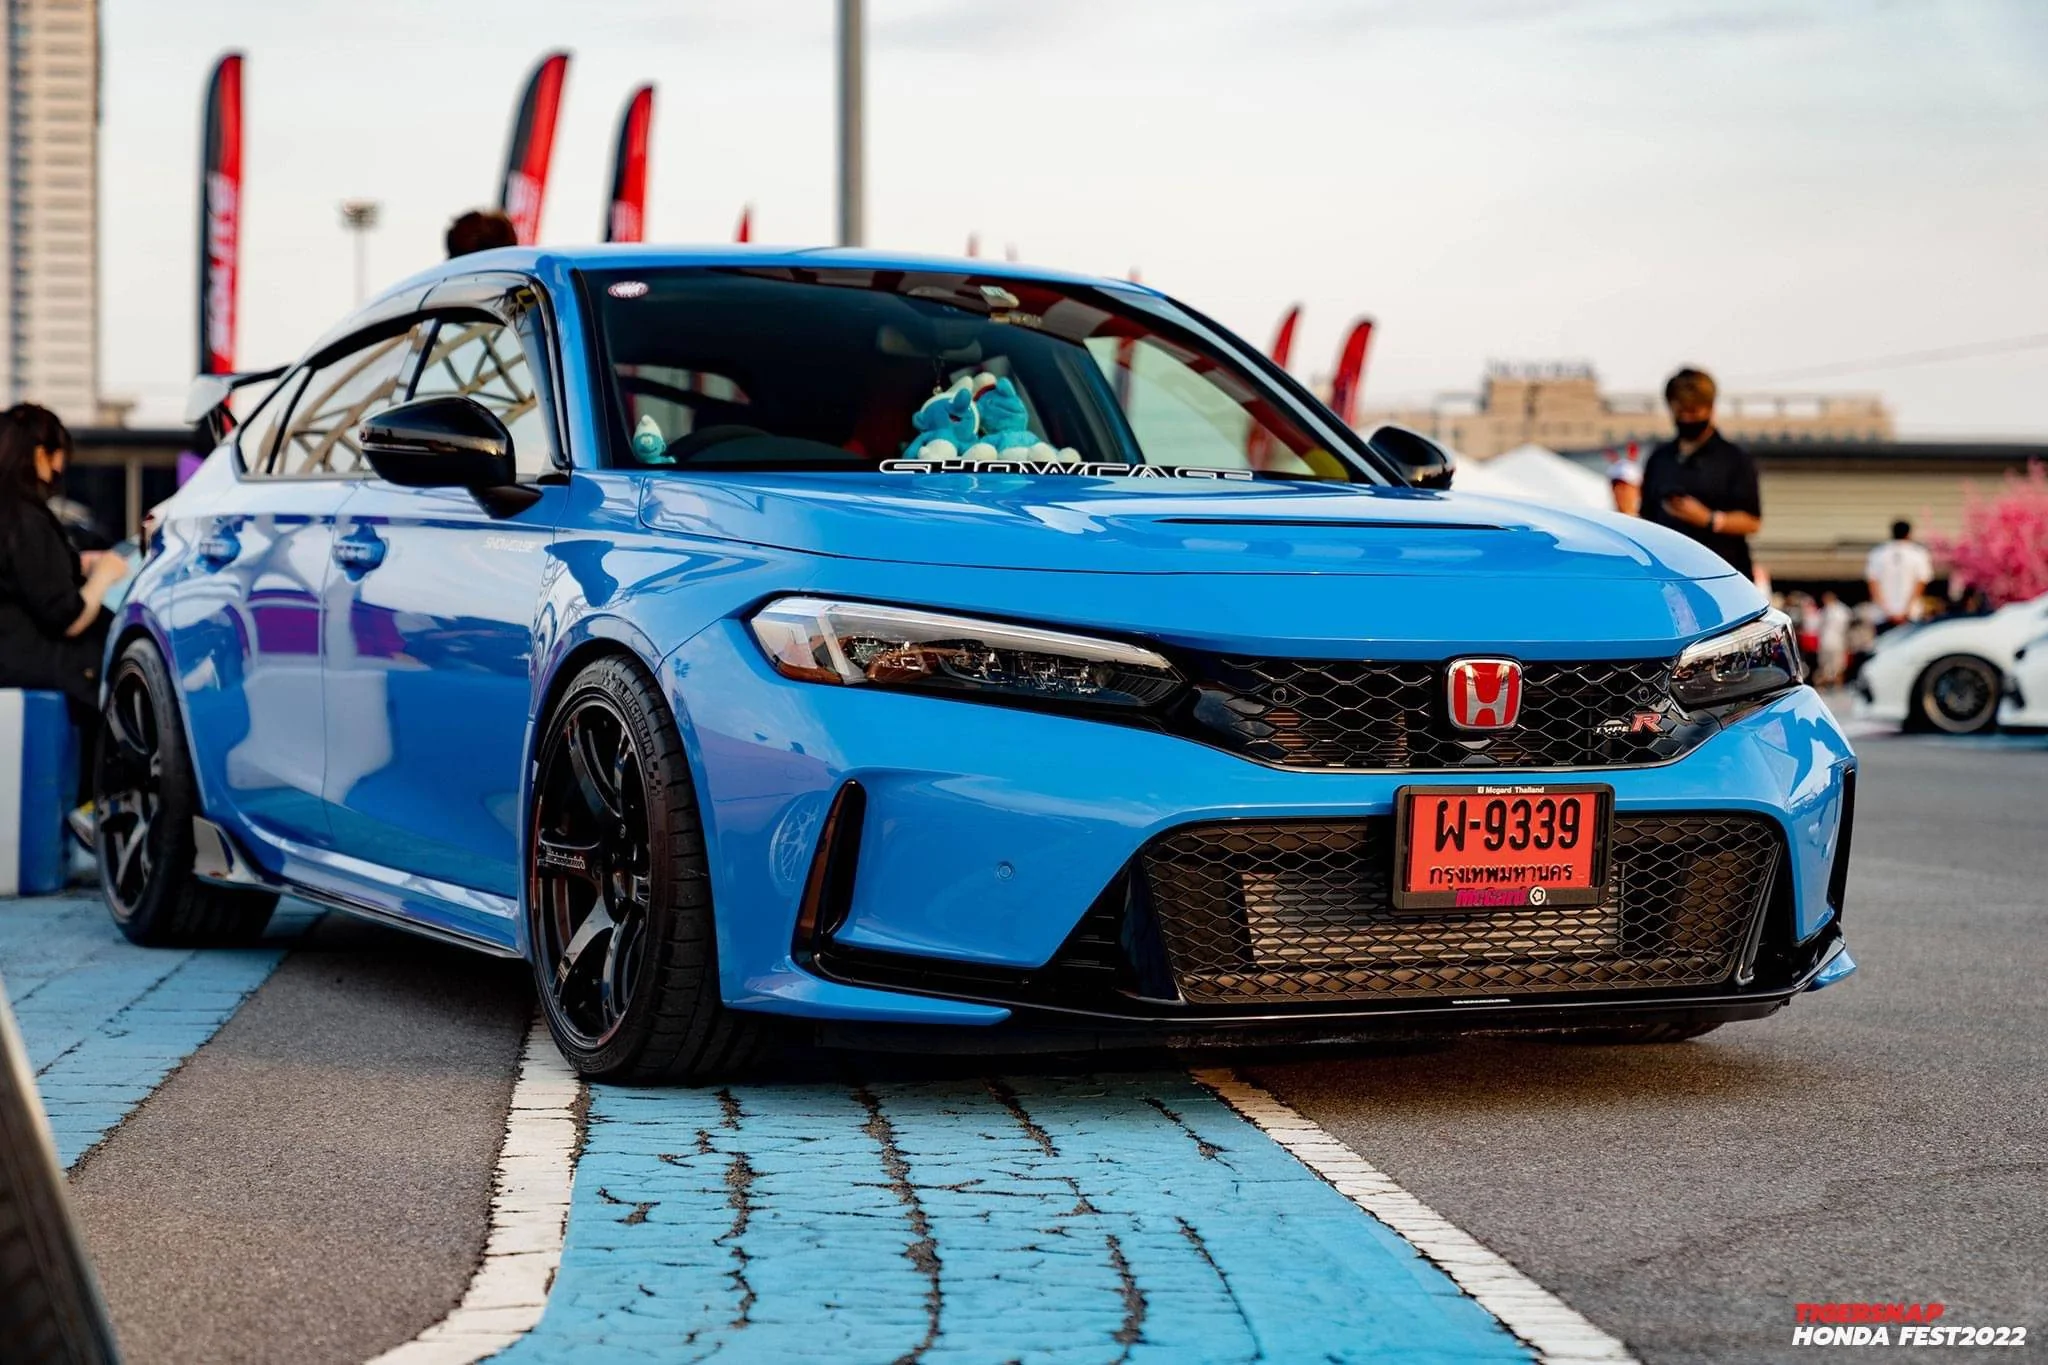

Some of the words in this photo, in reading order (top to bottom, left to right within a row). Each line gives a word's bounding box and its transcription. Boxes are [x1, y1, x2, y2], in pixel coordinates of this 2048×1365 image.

[622, 690, 655, 759] MICHELIN
[1632, 713, 1664, 733] R
[1515, 786, 1544, 794] Thailand
[1429, 864, 1573, 890] กรุงเทพมหานคร
